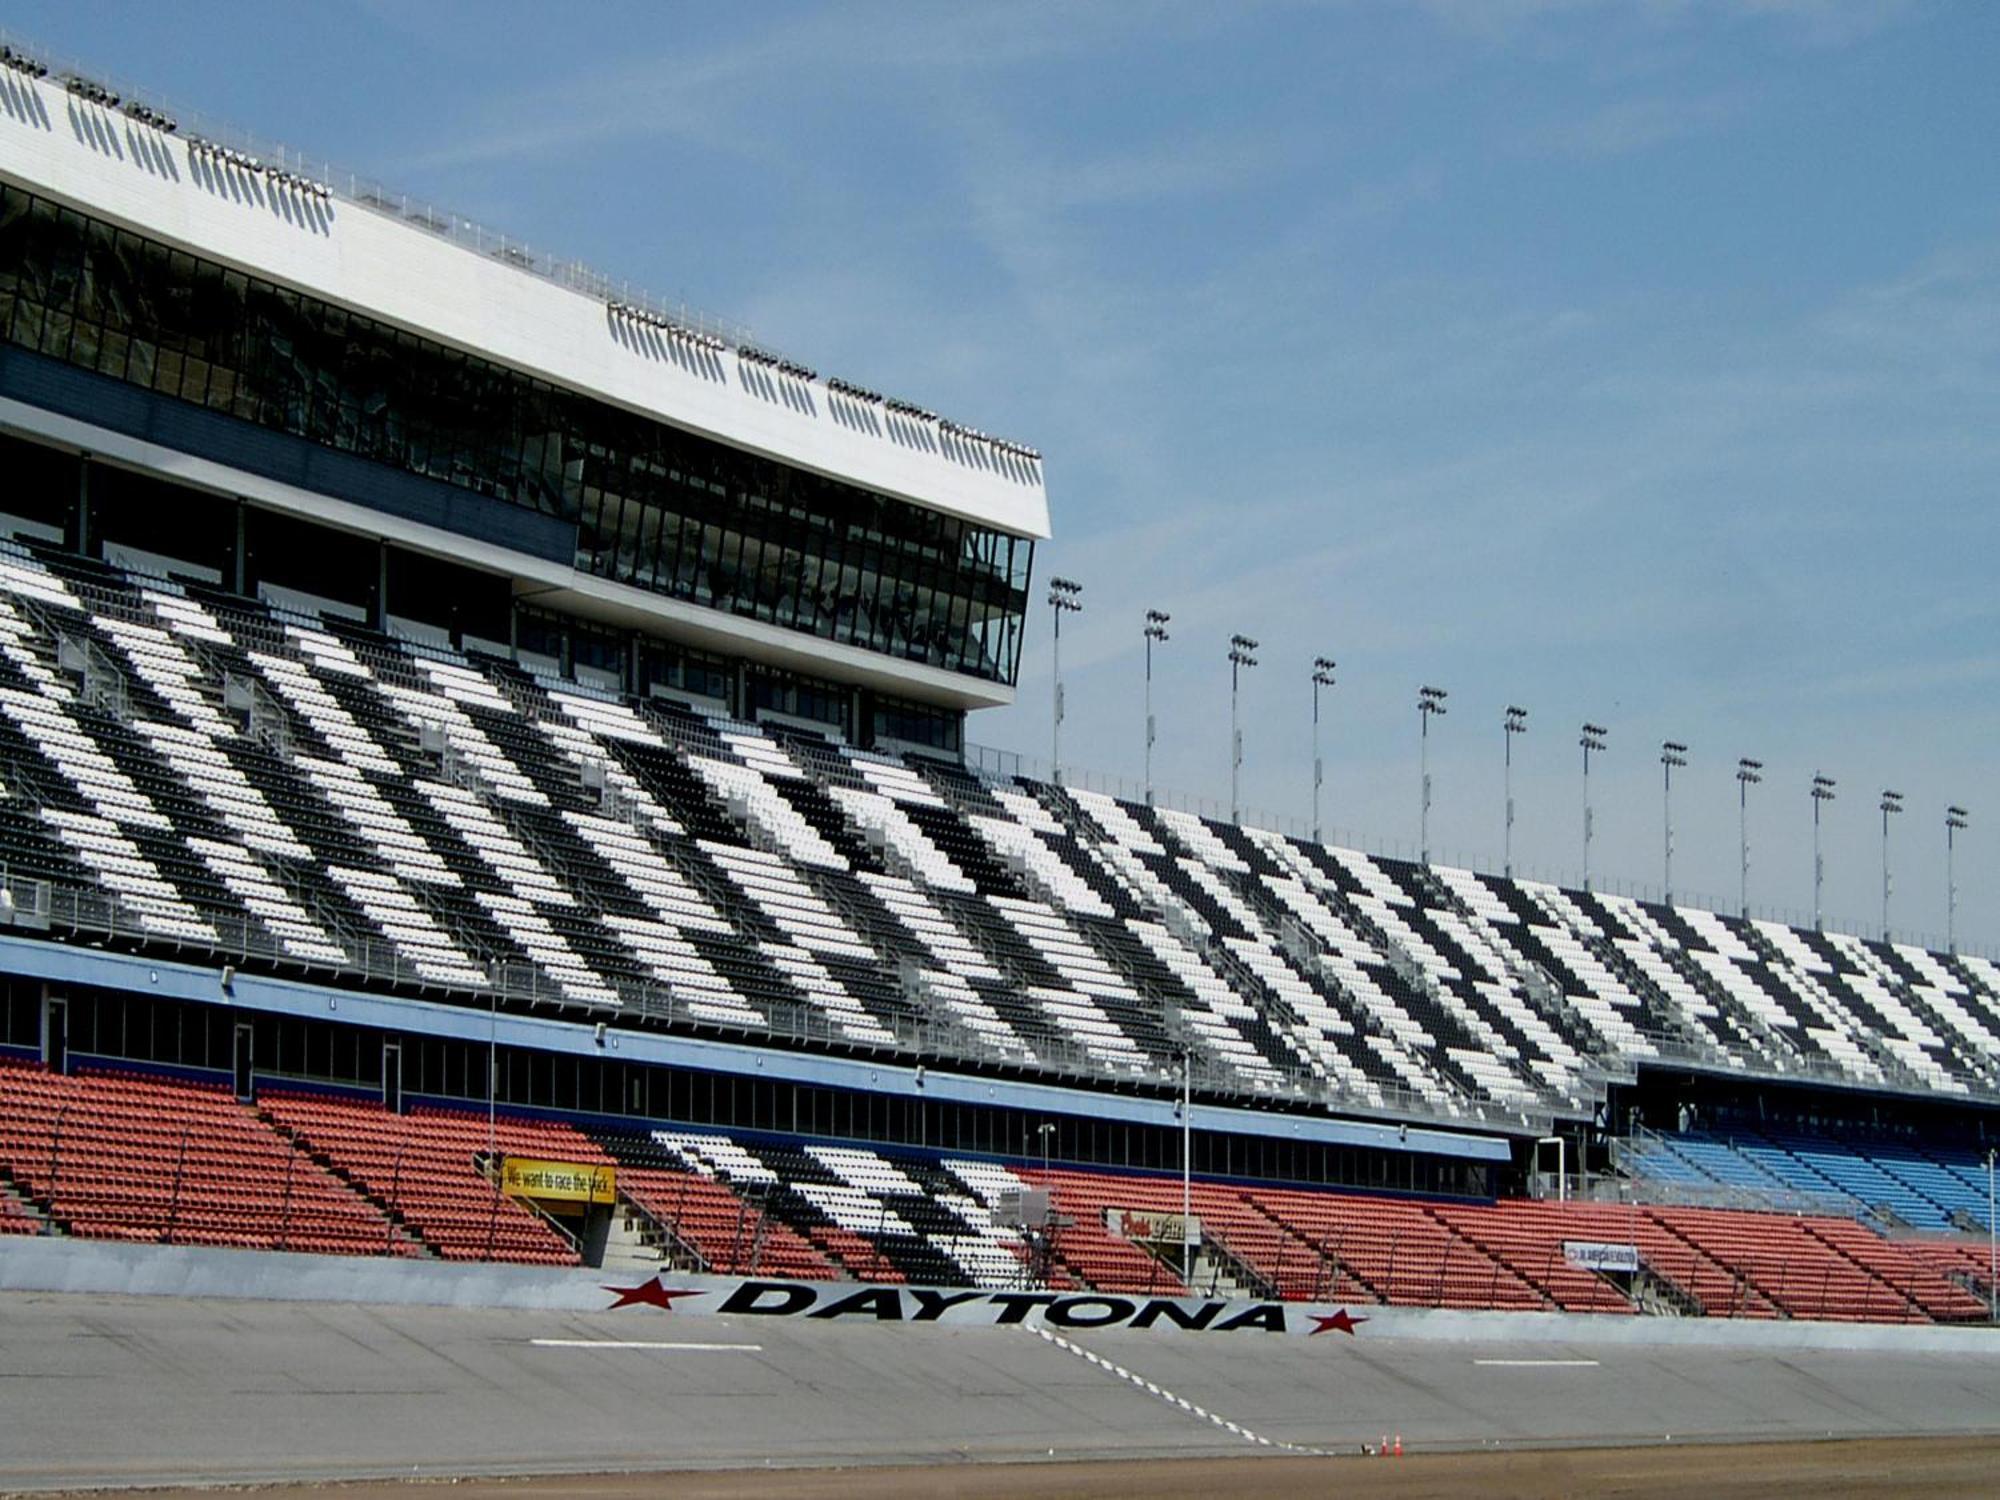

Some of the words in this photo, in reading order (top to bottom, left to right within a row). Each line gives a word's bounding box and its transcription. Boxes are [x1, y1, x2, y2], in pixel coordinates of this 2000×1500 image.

[508, 1167, 521, 1187] We
[523, 1171, 543, 1188] want
[545, 1172, 553, 1188] to
[555, 1174, 572, 1191] race
[573, 1173, 587, 1192] the
[588, 1174, 611, 1194] tuck.
[717, 1281, 1287, 1332] DAYTONA
